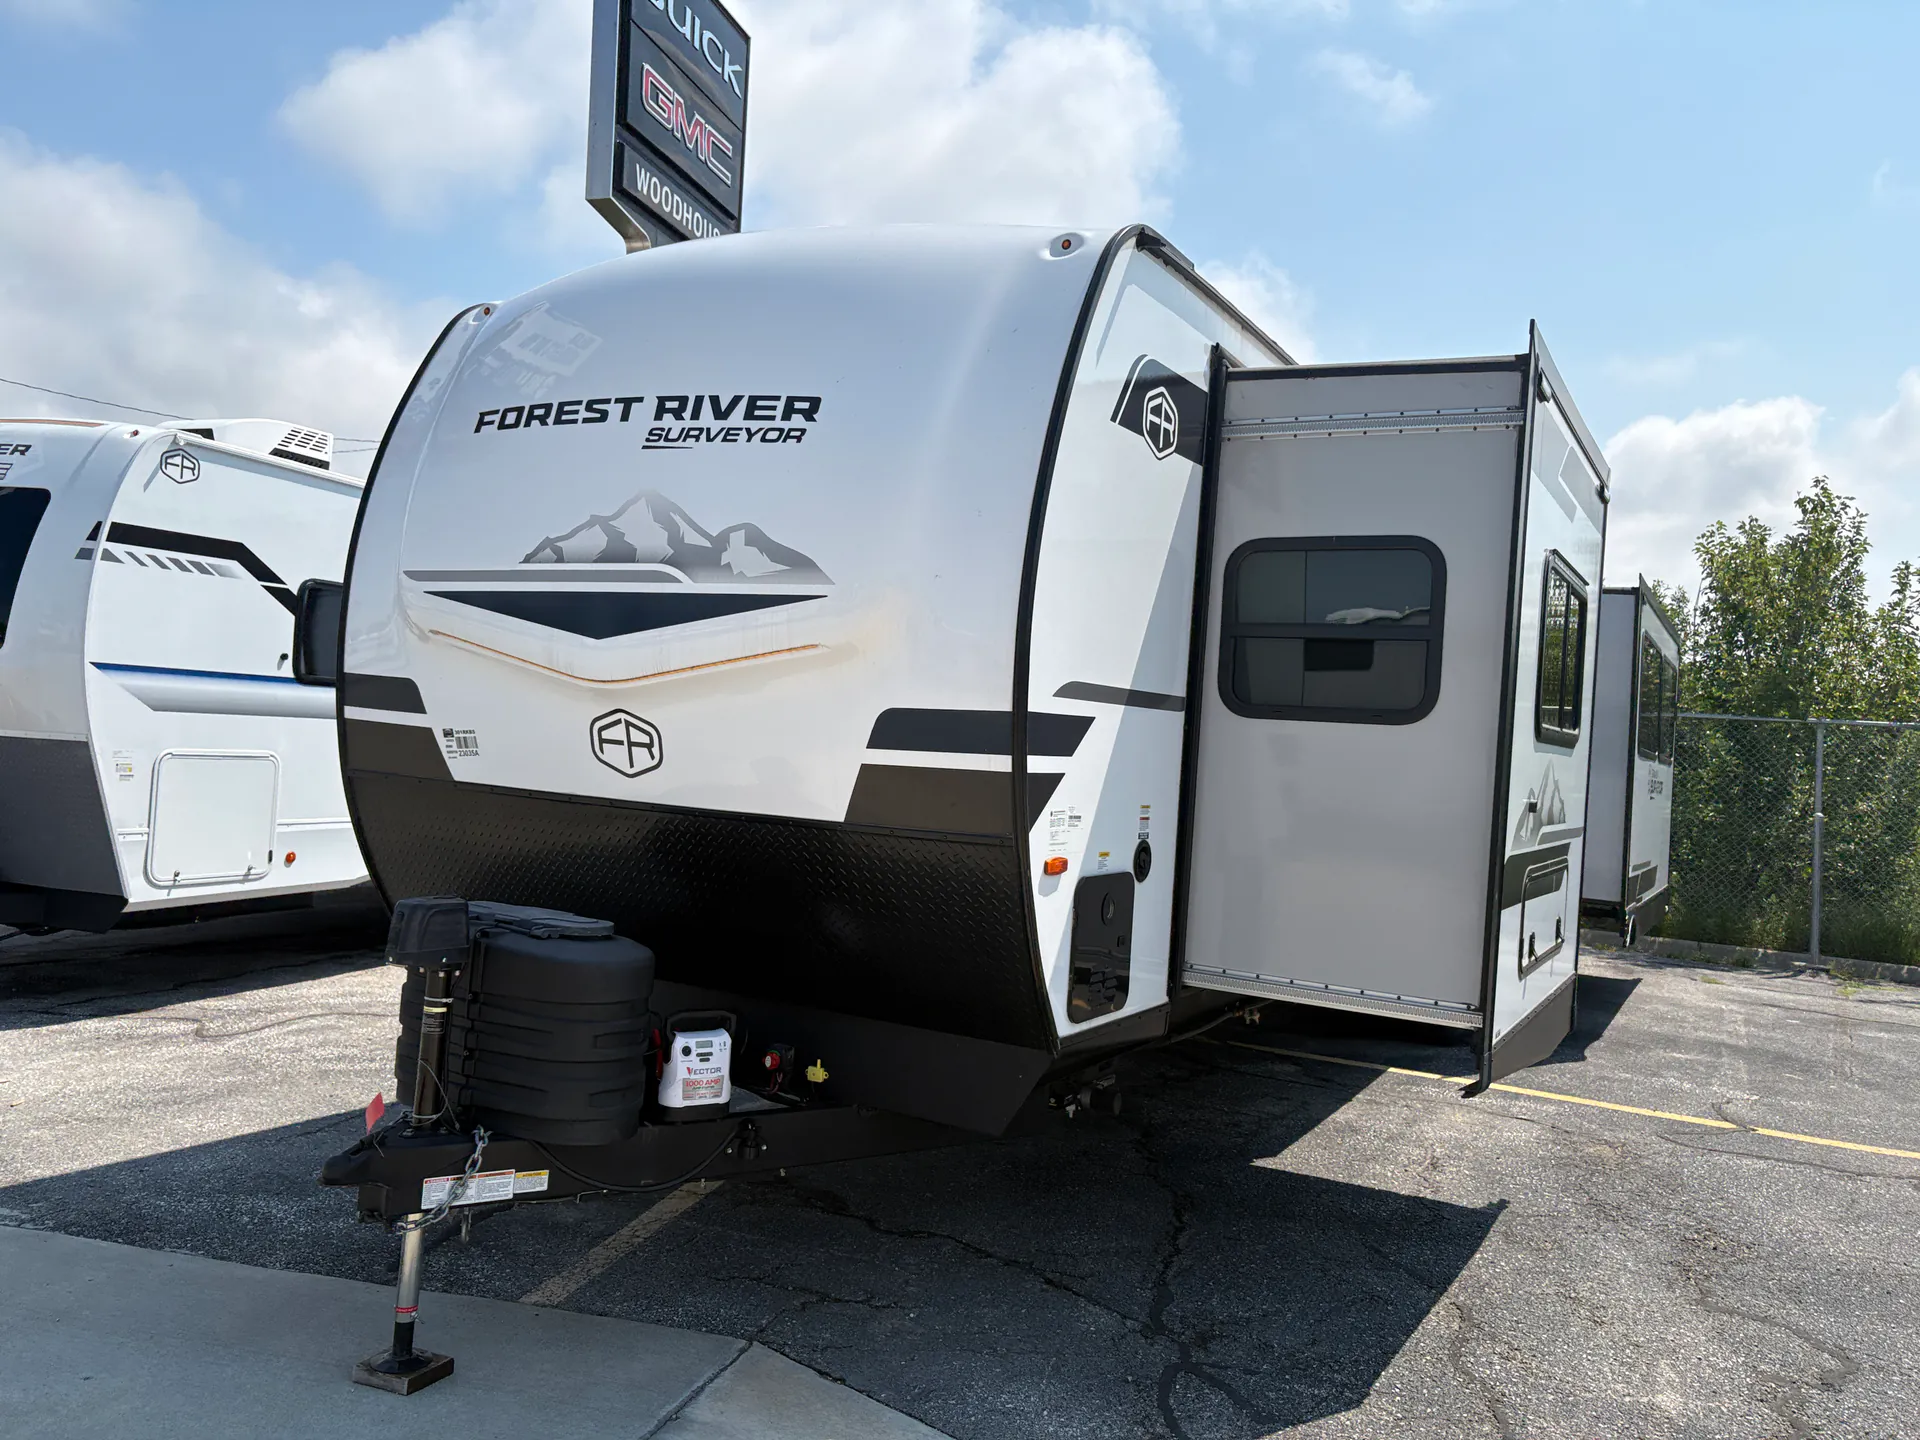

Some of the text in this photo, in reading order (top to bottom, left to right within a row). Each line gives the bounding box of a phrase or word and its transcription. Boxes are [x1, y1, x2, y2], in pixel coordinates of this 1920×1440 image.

[647, 0, 743, 99] UICK
[642, 62, 733, 187] GMC
[473, 395, 823, 434] FOREST RIVER
[644, 426, 807, 444] SURVEYOR
[686, 1066, 721, 1077] VECTOR
[704, 1078, 721, 1086] AMP
